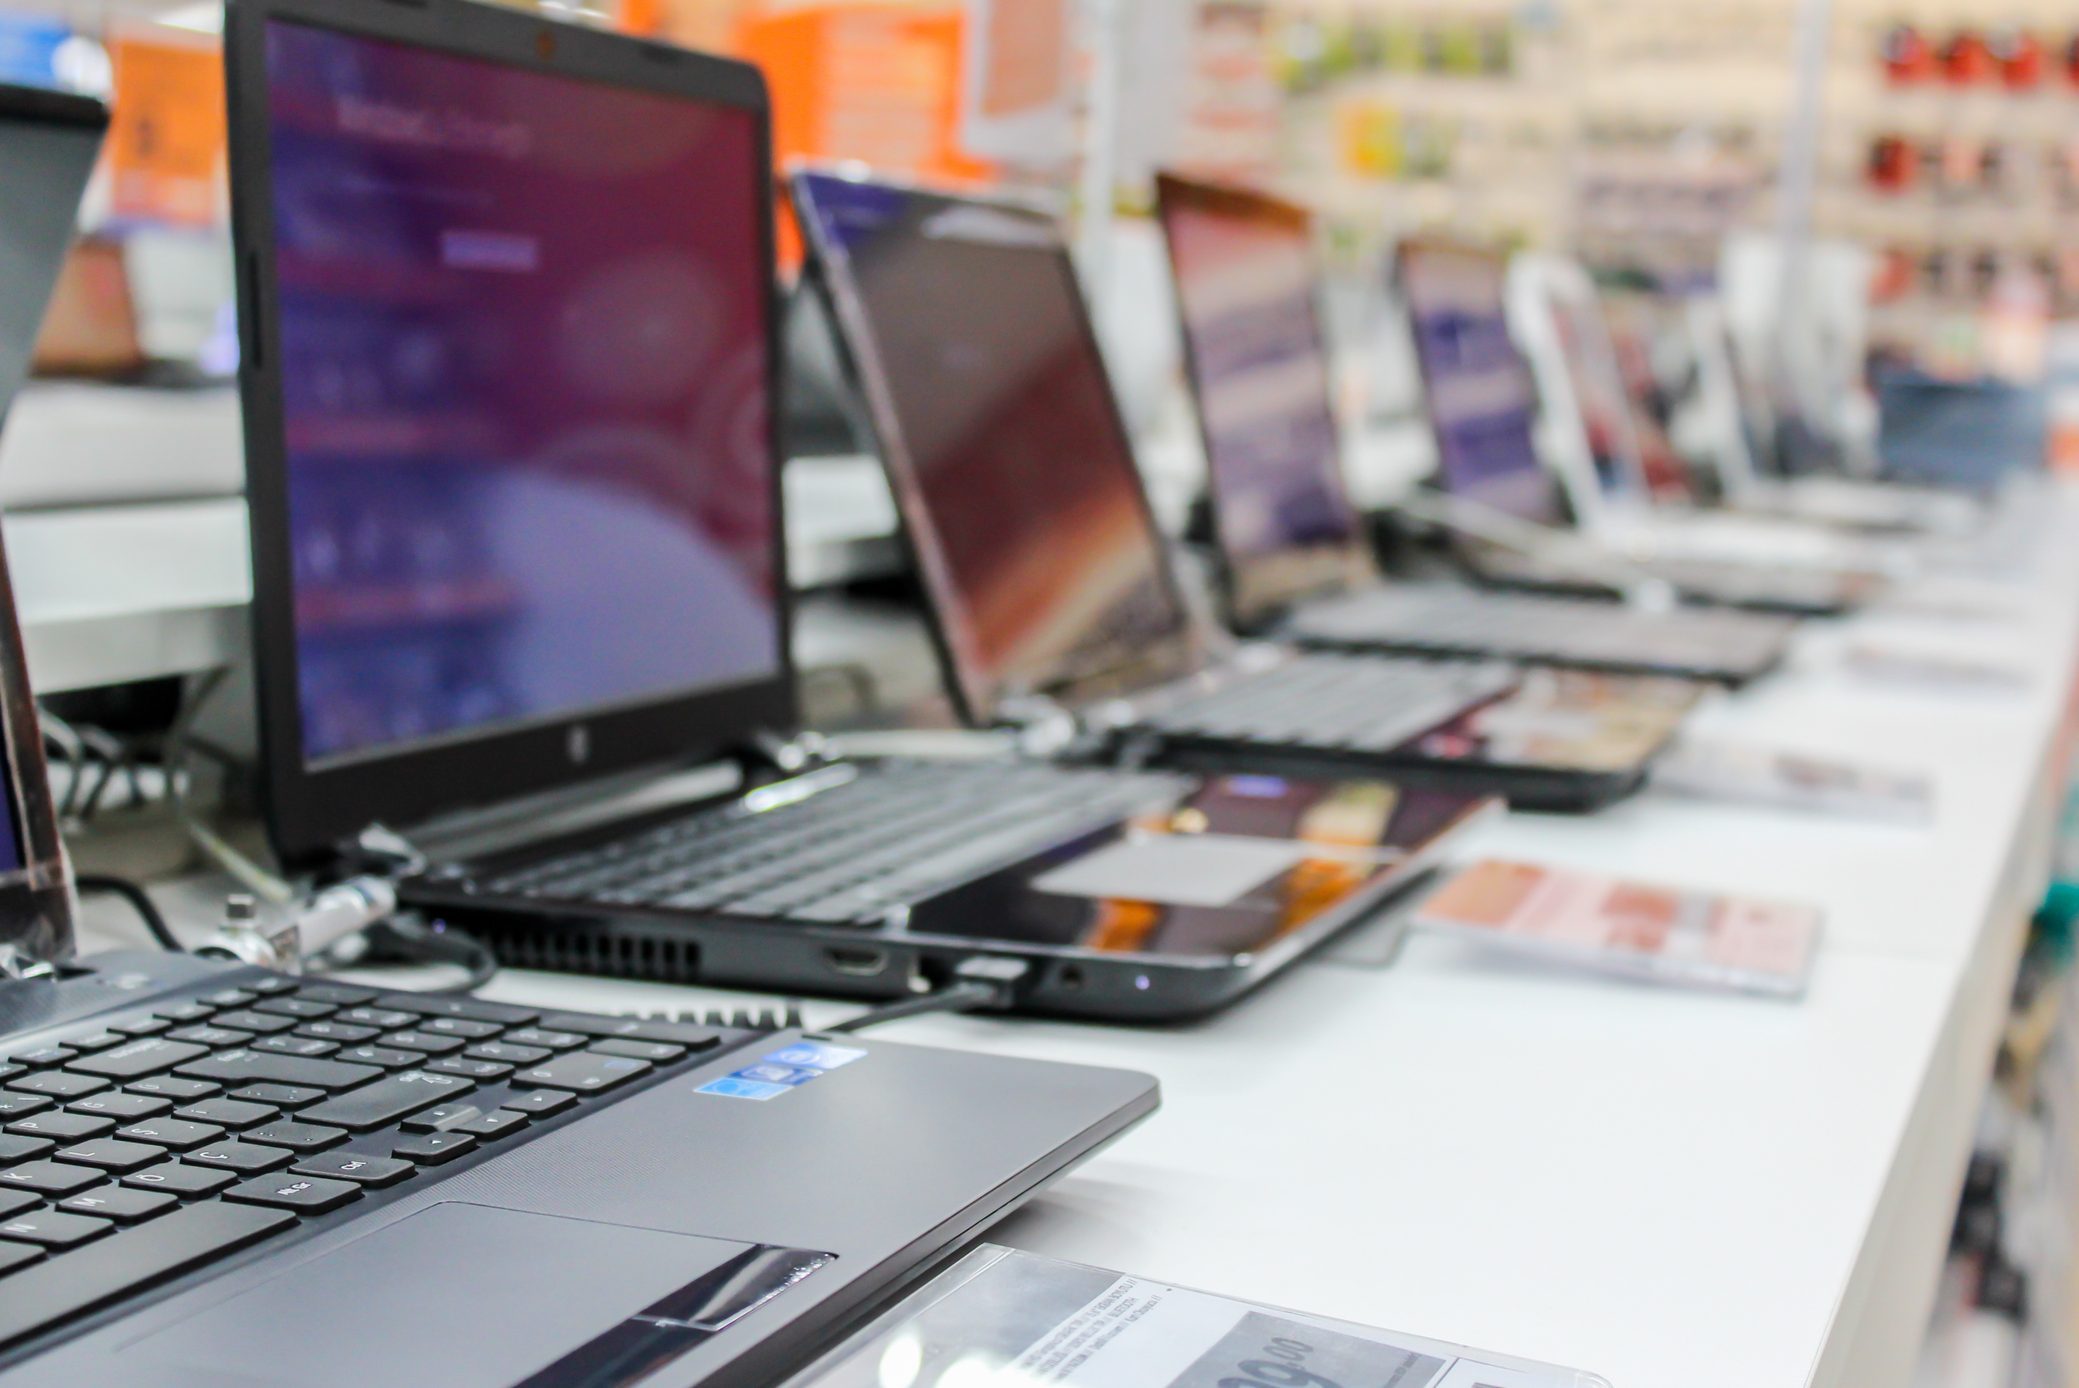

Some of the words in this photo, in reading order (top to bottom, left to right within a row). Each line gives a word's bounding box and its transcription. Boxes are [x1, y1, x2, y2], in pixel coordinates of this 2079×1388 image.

[3, 1172, 33, 1181] K
[72, 1197, 106, 1207] M
[4, 1223, 37, 1233] N
